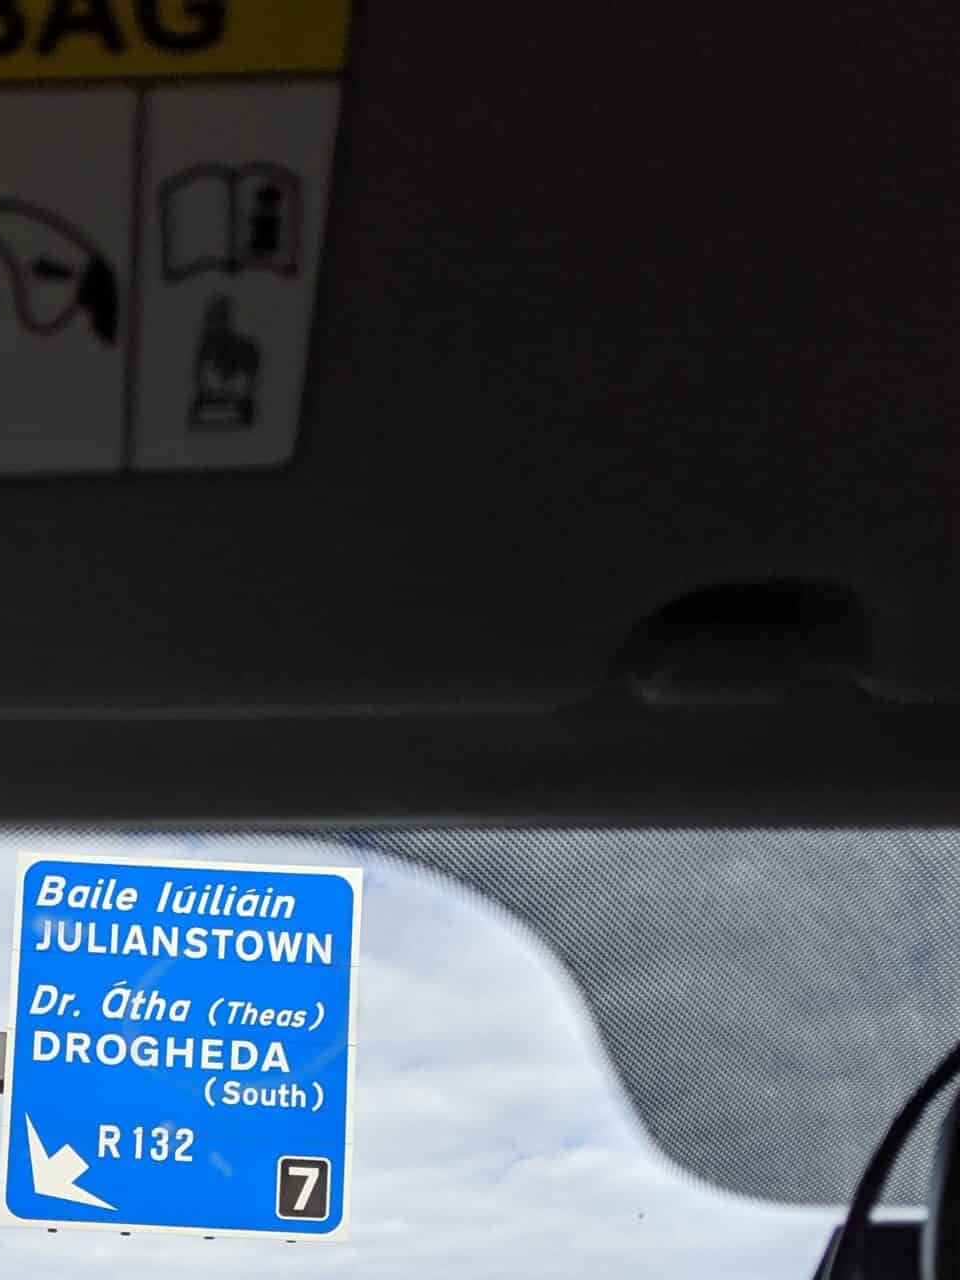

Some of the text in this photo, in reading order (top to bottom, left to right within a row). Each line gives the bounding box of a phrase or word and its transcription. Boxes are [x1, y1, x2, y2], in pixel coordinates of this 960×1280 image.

[37, 876, 295, 918] Baile Iúiliáin
[35, 921, 332, 964] JULIANSTOWN
[30, 981, 324, 1030] Dr. Átha (Theas)
[33, 1031, 289, 1072] DROGHEDA
[205, 1077, 323, 1111] (South)
[289, 1167, 319, 1210] 7
